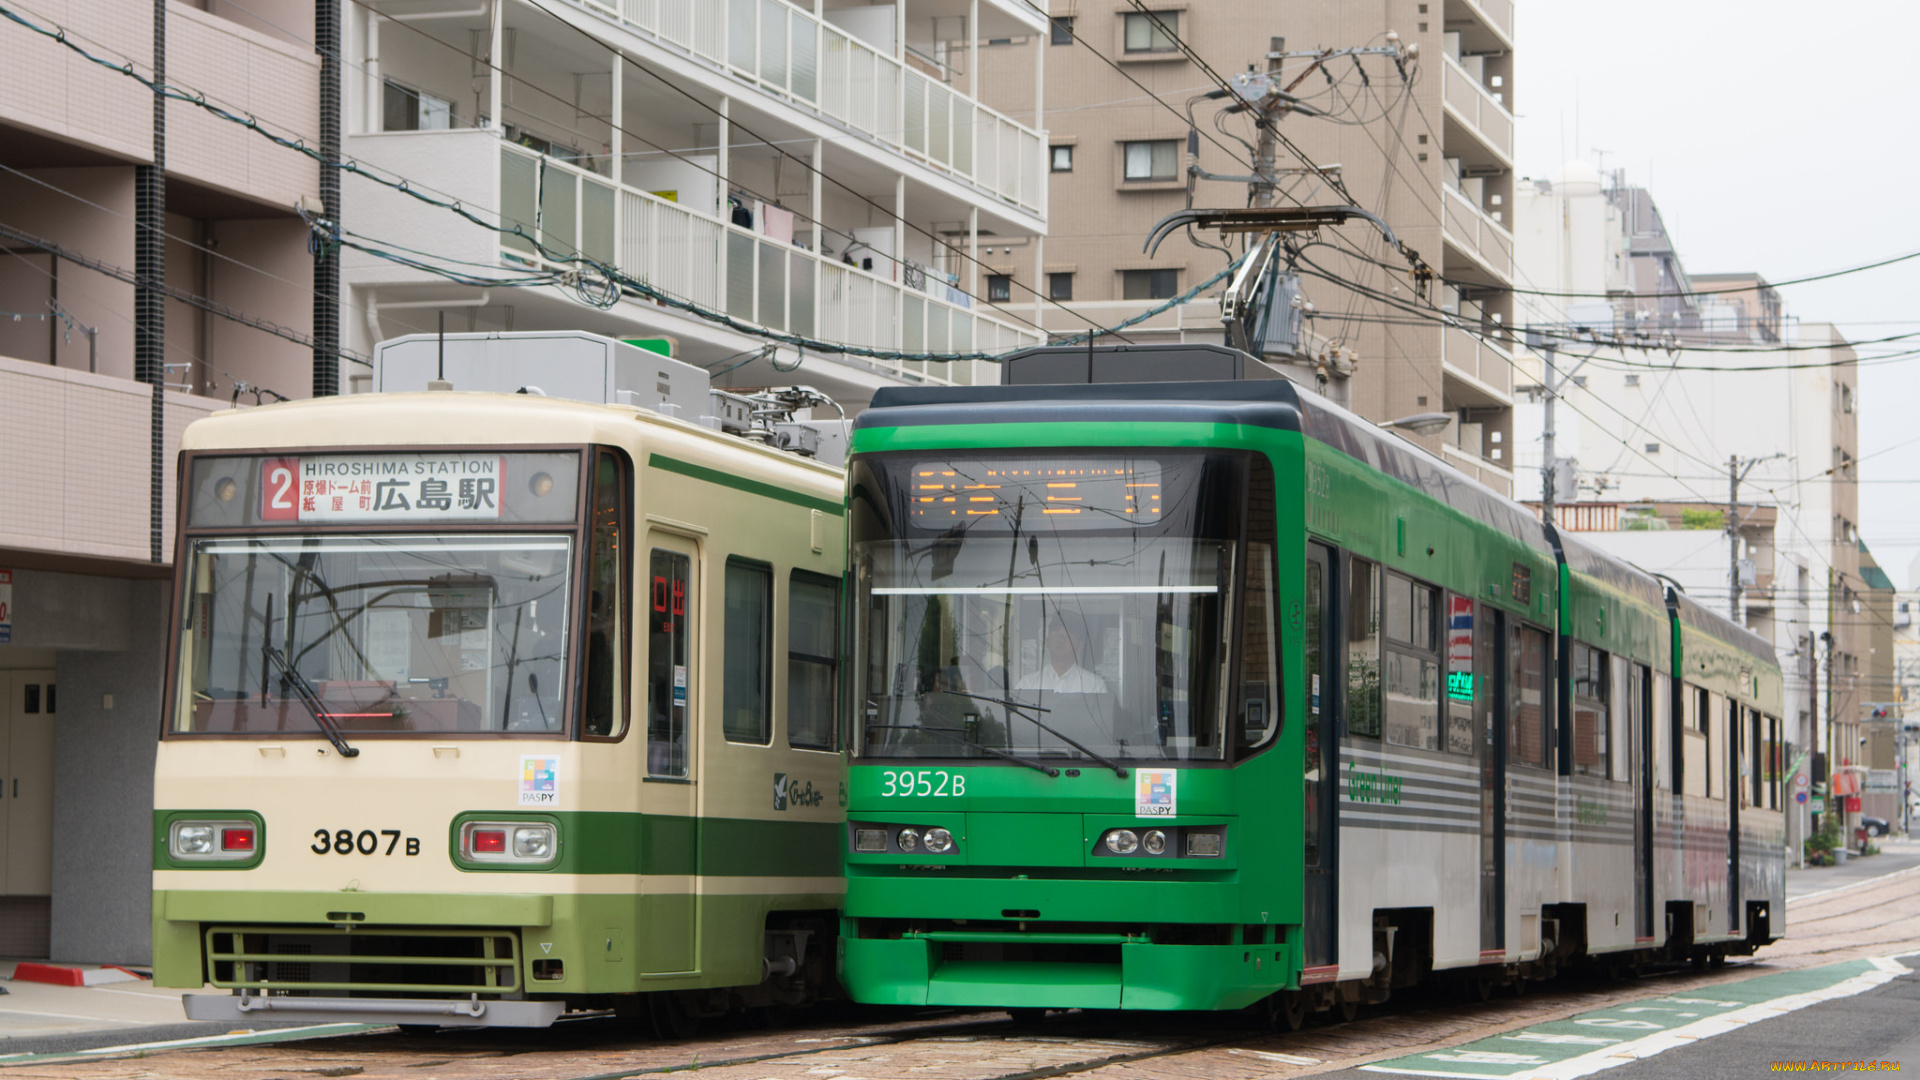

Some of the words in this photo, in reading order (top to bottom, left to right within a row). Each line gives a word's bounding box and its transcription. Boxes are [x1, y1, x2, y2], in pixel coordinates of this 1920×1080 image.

[305, 461, 409, 476] HIROSHIMA
[414, 460, 494, 475] STATION
[270, 467, 292, 509] 2
[302, 479, 372, 496] 原爆ドーム前
[372, 477, 495, 511] 広島駅
[881, 770, 966, 798] 3952B
[1348, 760, 1377, 804] Green
[522, 792, 555, 803] PASPY
[1139, 805, 1172, 816] PASPY
[310, 828, 421, 857] 3807B
